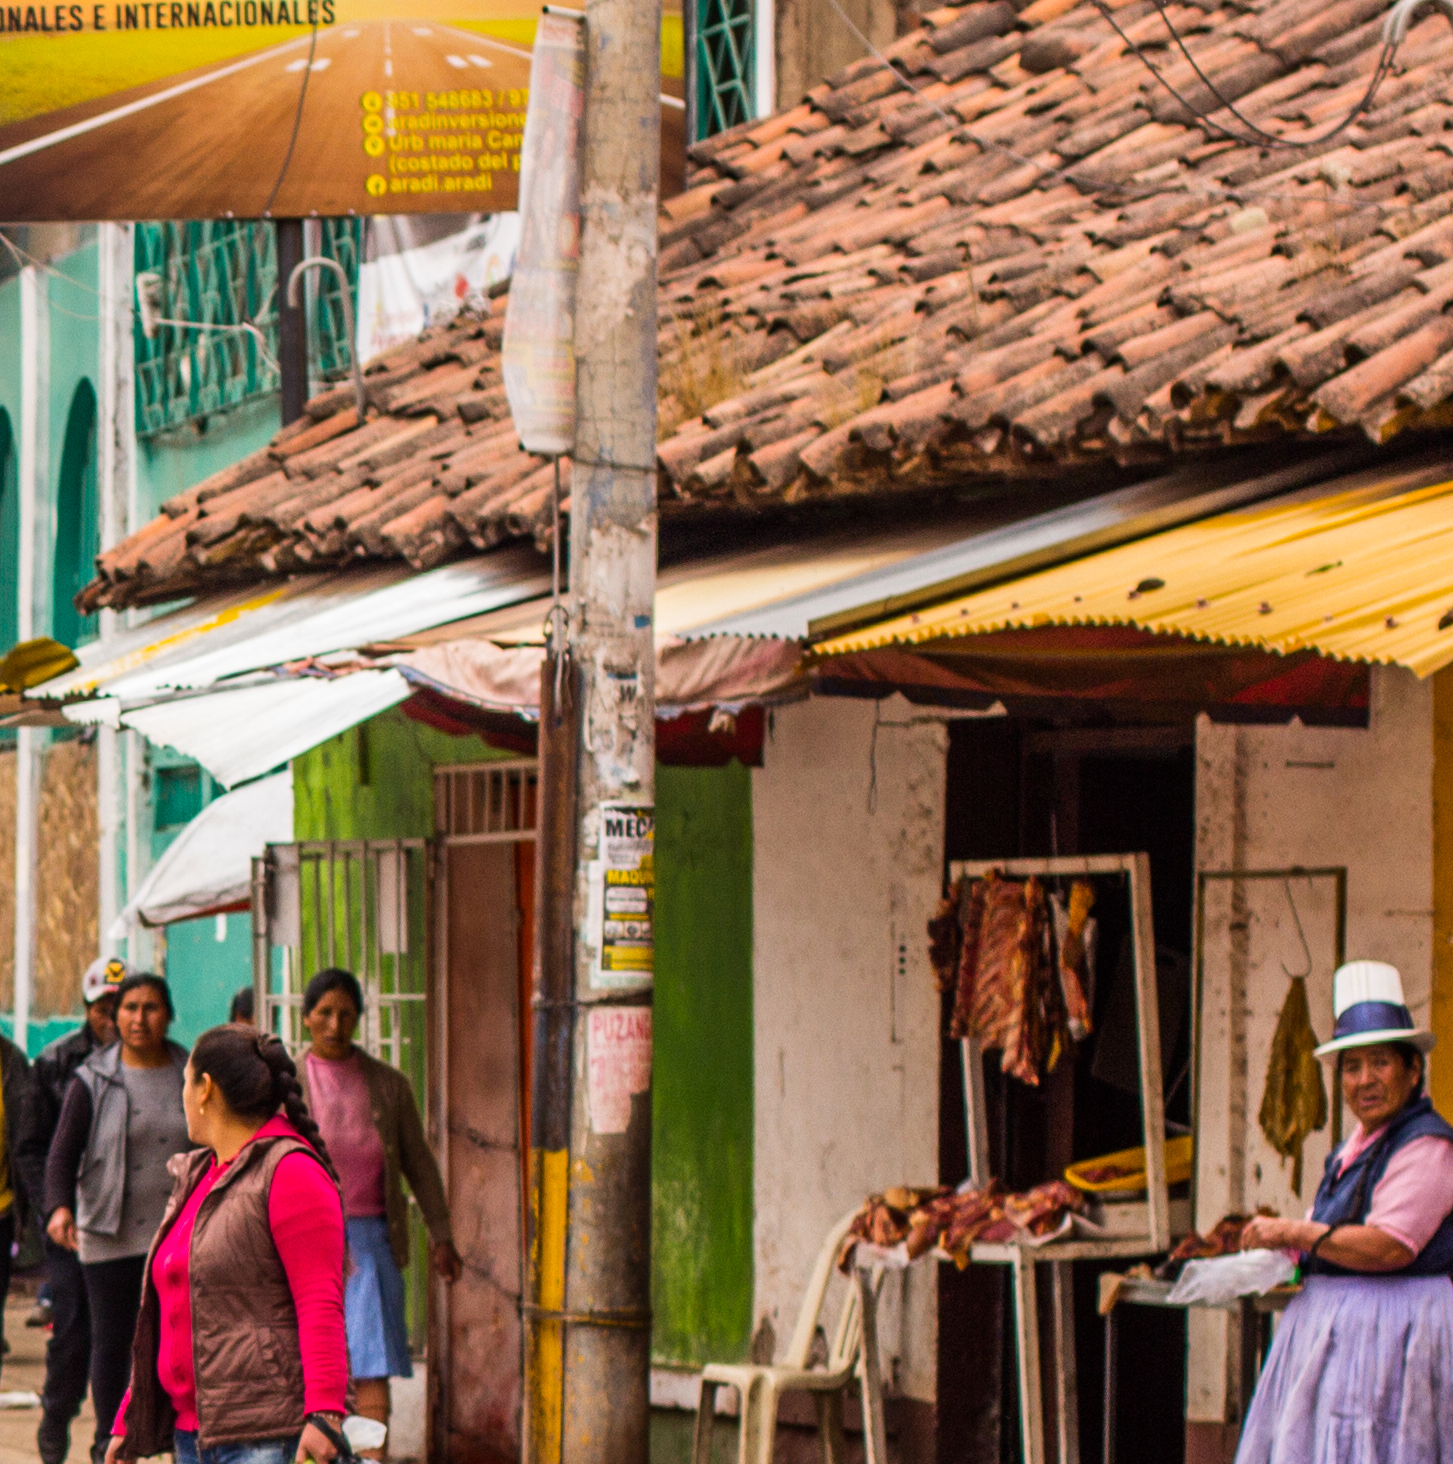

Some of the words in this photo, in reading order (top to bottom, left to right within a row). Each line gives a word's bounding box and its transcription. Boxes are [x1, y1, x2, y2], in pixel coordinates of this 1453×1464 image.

[94, 3, 106, 30] E
[115, 0, 336, 30] INTERNACIONALES
[477, 150, 508, 172] del
